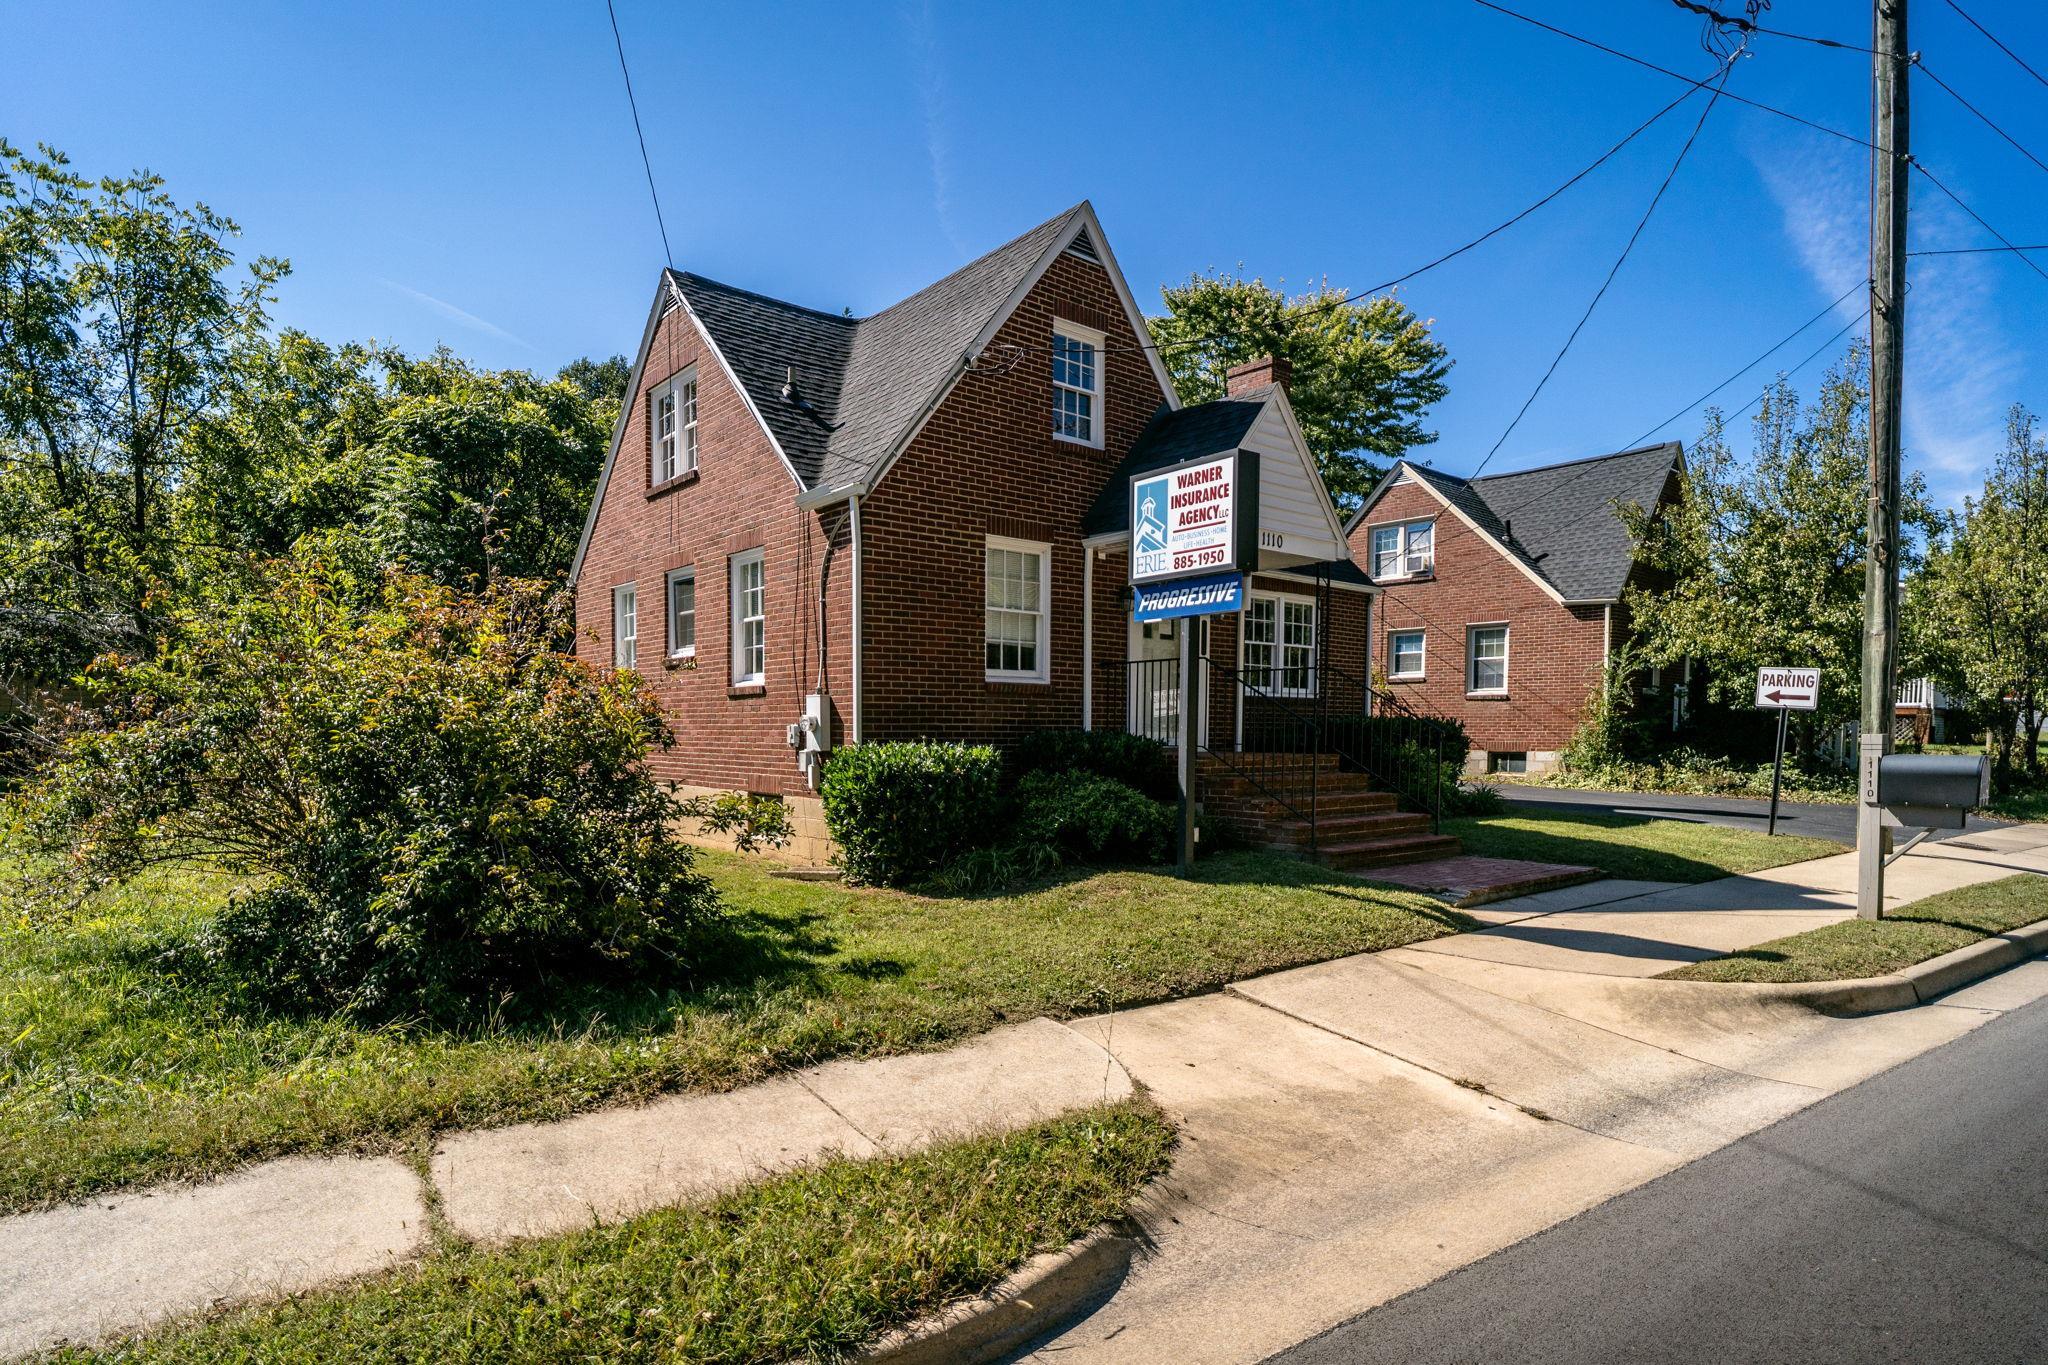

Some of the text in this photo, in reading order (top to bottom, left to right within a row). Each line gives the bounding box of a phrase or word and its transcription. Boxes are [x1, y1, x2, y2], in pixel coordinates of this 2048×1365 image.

[1177, 465, 1222, 489] WARNER
[1170, 483, 1230, 510] INSURANCE
[1179, 505, 1229, 526] AGENCY LLC
[1261, 531, 1283, 548] 1110
[1136, 552, 1167, 574] ERIE
[1173, 549, 1224, 570] 885-1950
[1139, 581, 1239, 612] PROGRESSIVE
[1761, 673, 1815, 688] PARKING
